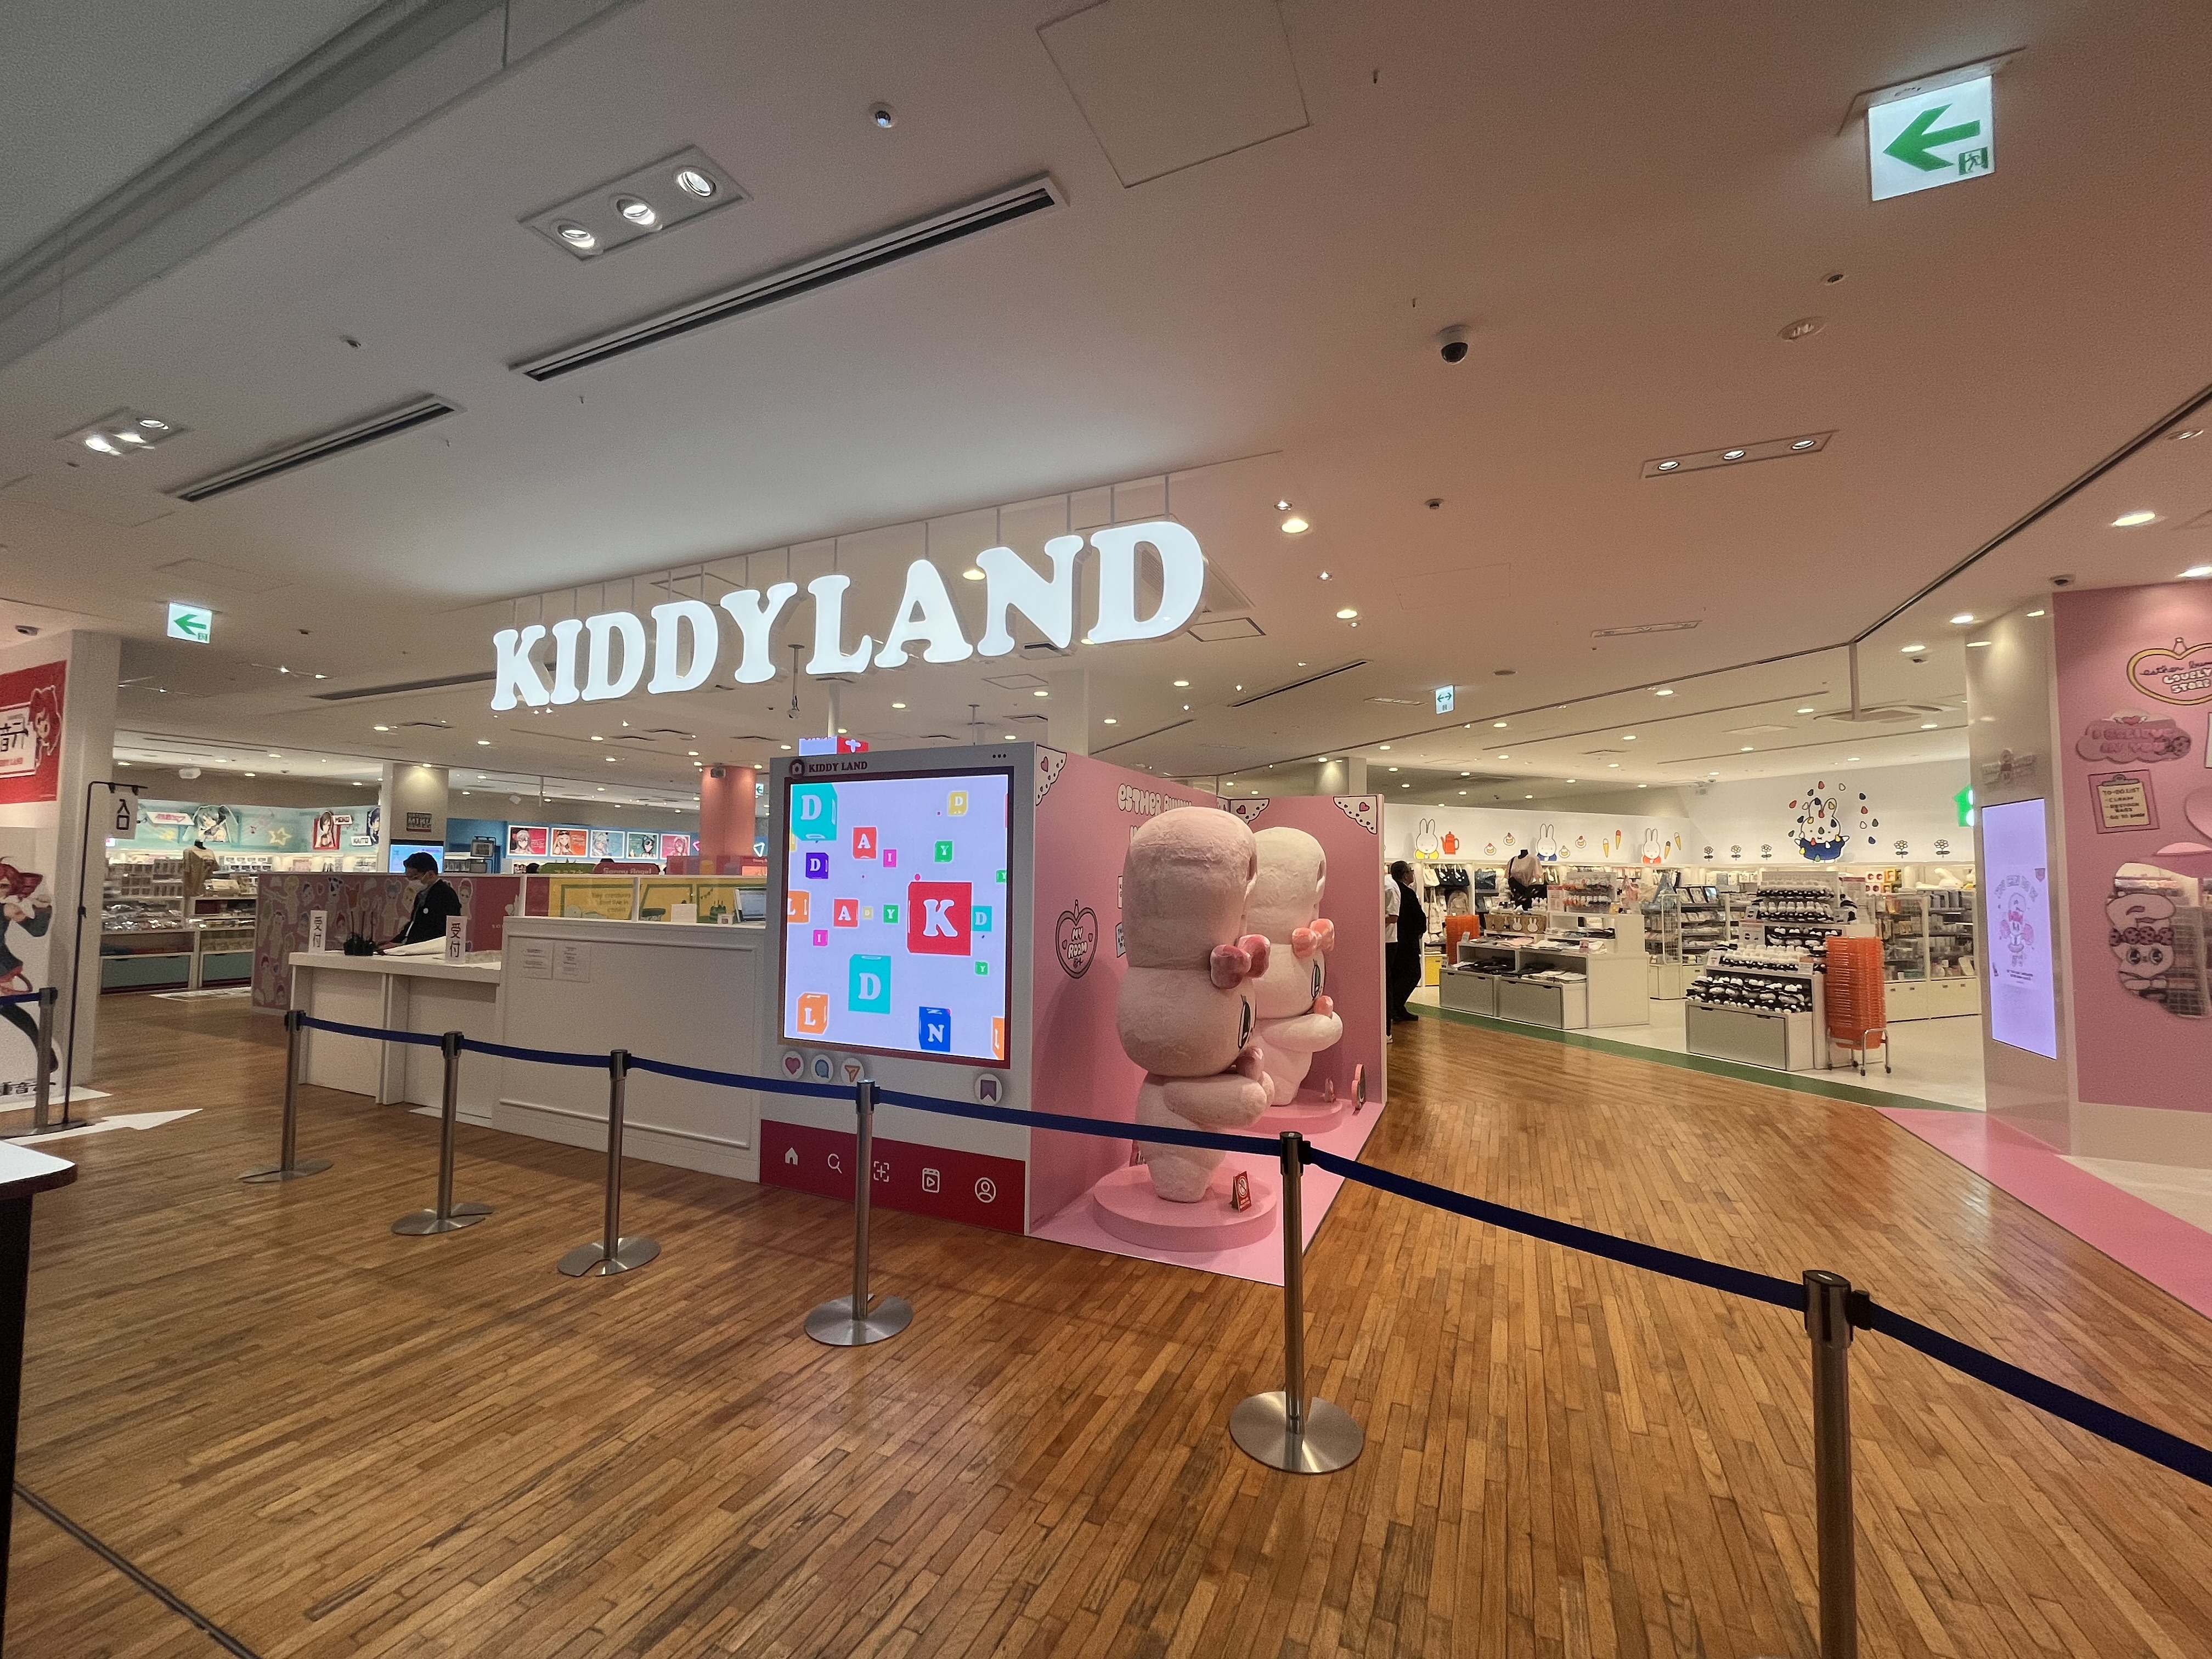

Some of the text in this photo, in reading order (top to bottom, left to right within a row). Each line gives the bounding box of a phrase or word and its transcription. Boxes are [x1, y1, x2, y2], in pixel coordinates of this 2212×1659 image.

[809, 761, 868, 773] KIDDY LAND
[800, 794, 822, 820] D
[955, 796, 963, 806] D
[116, 799, 130, 830] 入口
[857, 833, 871, 849] A
[940, 845, 950, 856] Y
[810, 858, 821, 872] D
[838, 905, 851, 921] A
[887, 909, 895, 919] Y
[923, 899, 958, 937] K
[975, 912, 987, 926] D
[313, 916, 323, 949] 受付
[449, 922, 461, 958] 受付
[1071, 926, 1084, 941] MY
[1067, 941, 1088, 960] ROOM
[858, 973, 882, 1000] D
[804, 1008, 816, 1026] L
[927, 1023, 945, 1043] N
